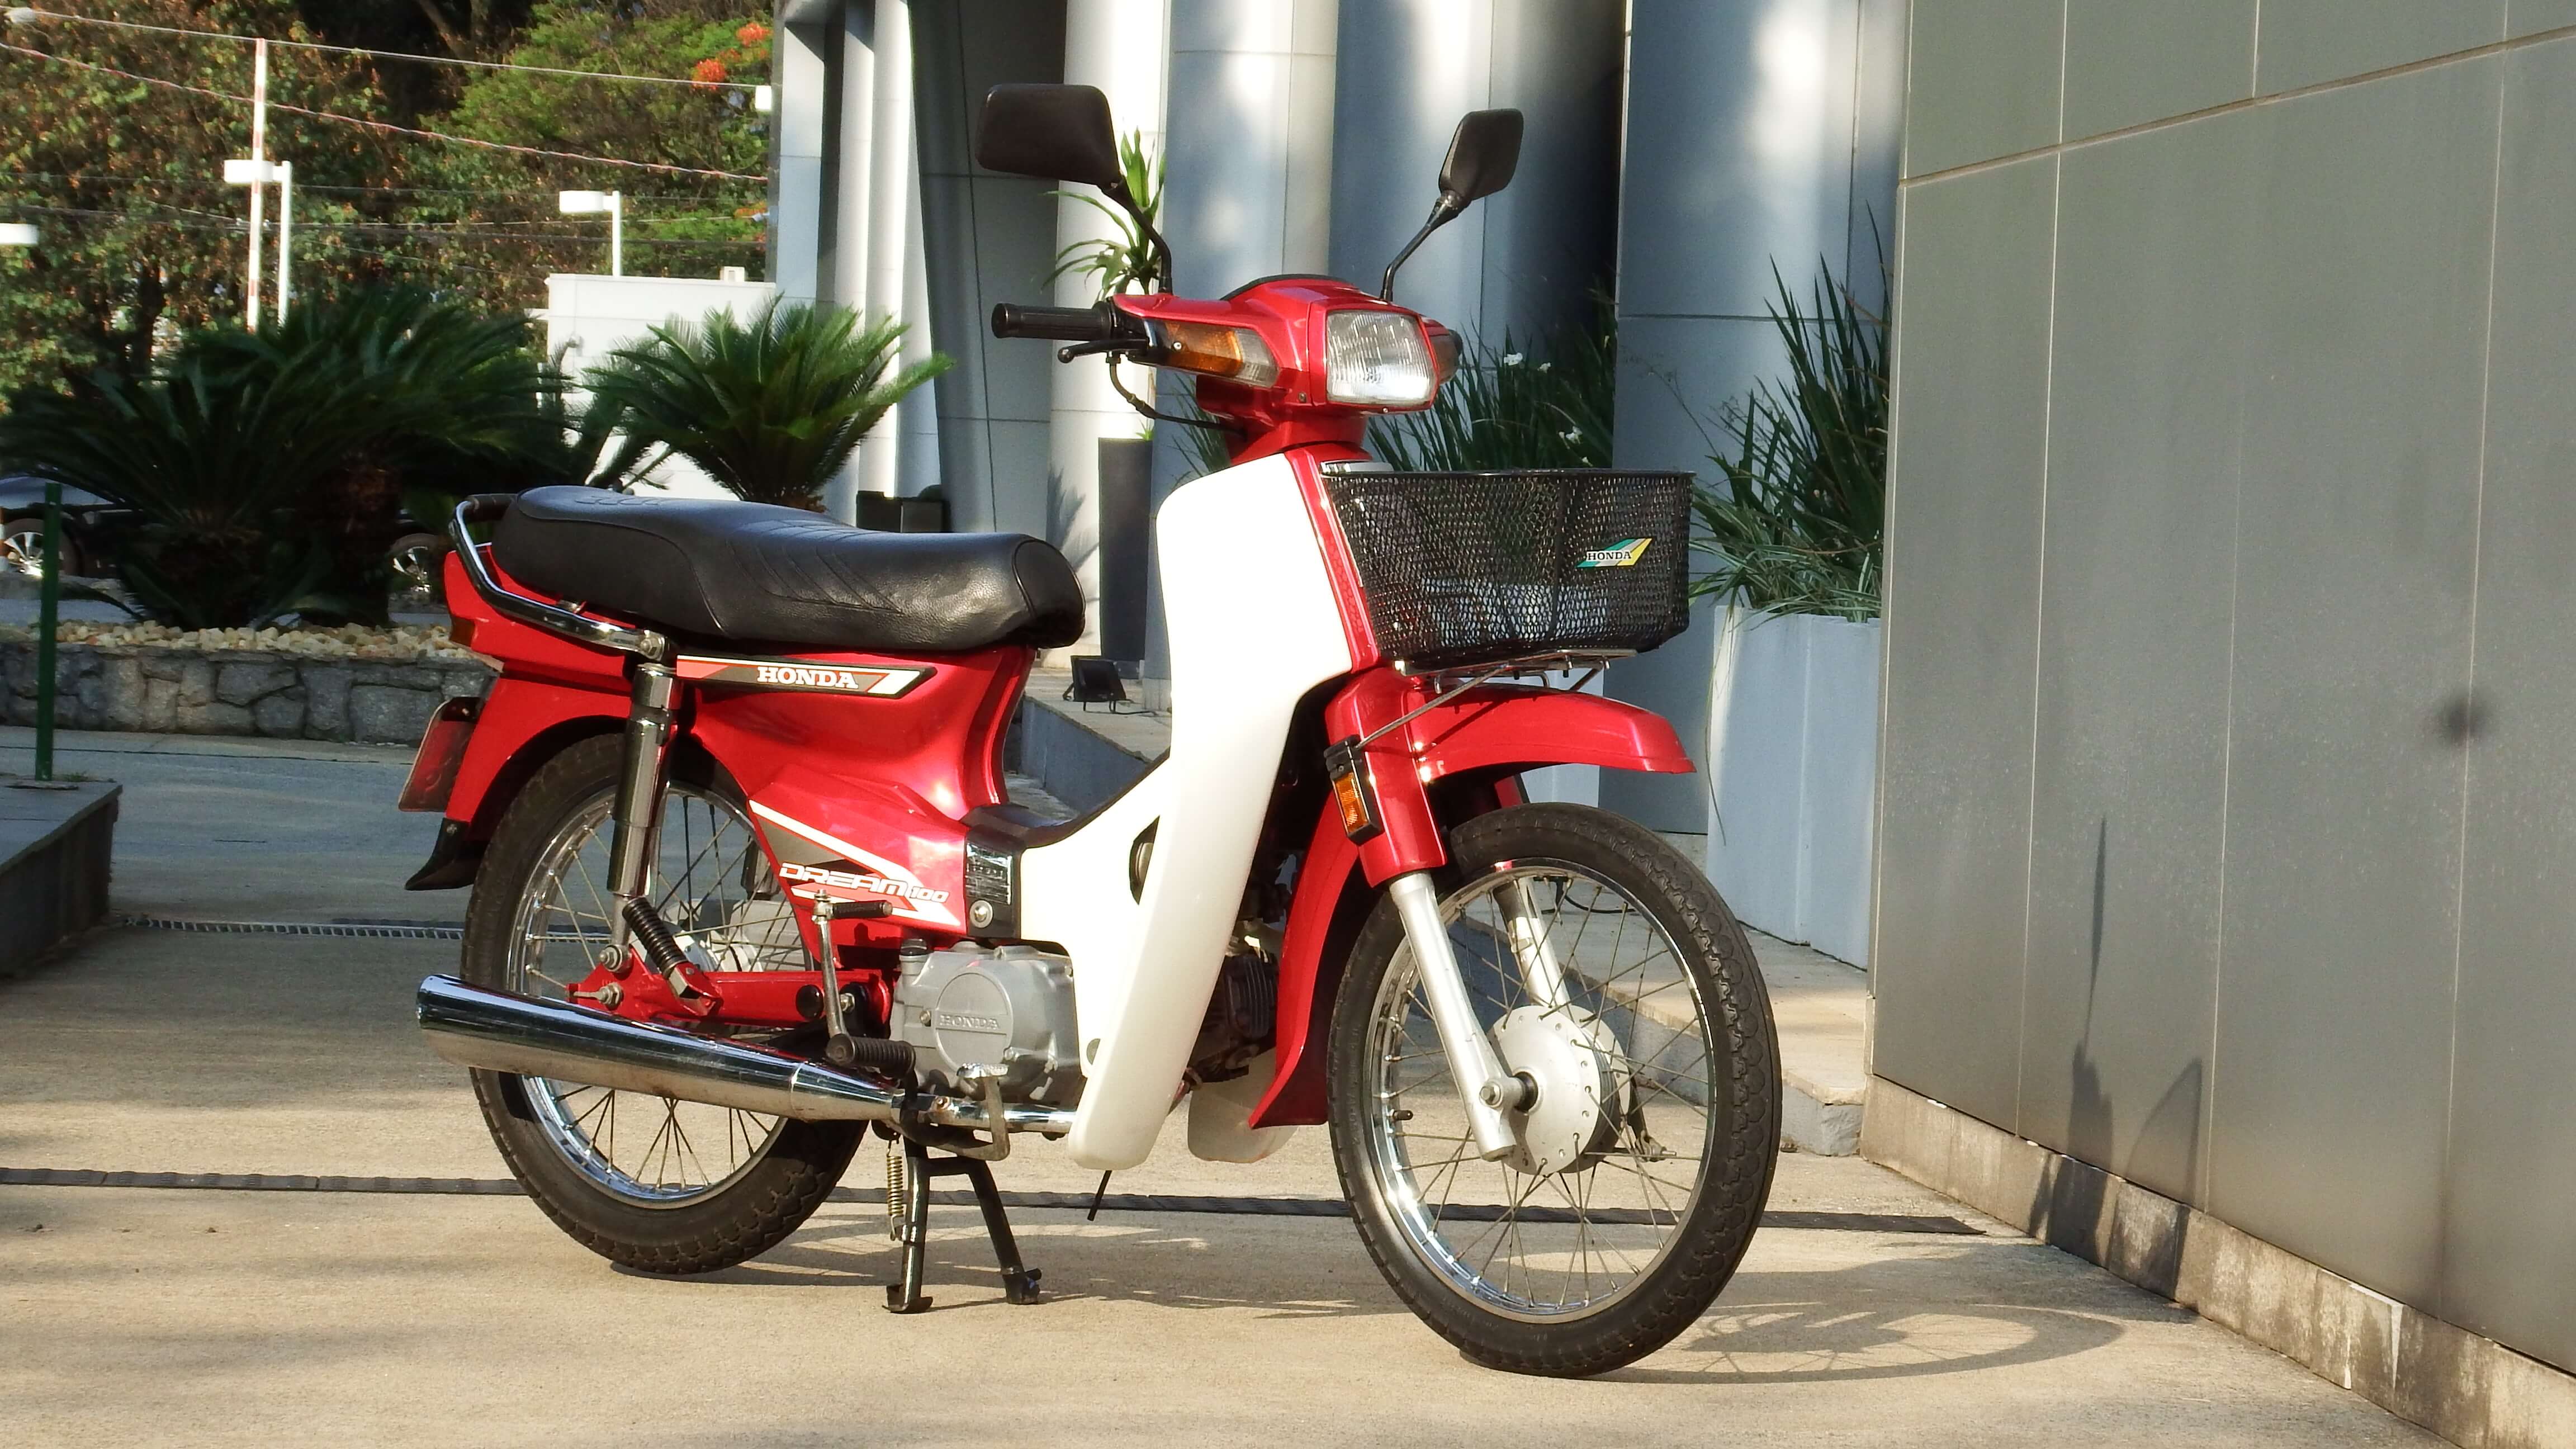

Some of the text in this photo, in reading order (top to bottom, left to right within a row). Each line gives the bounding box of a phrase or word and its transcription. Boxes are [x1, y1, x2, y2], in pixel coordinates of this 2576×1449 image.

[1587, 551, 1632, 561] HONDA
[757, 666, 858, 689] HONDA
[779, 863, 950, 903] DREAM 100
[939, 1014, 1001, 1030] HONDA
